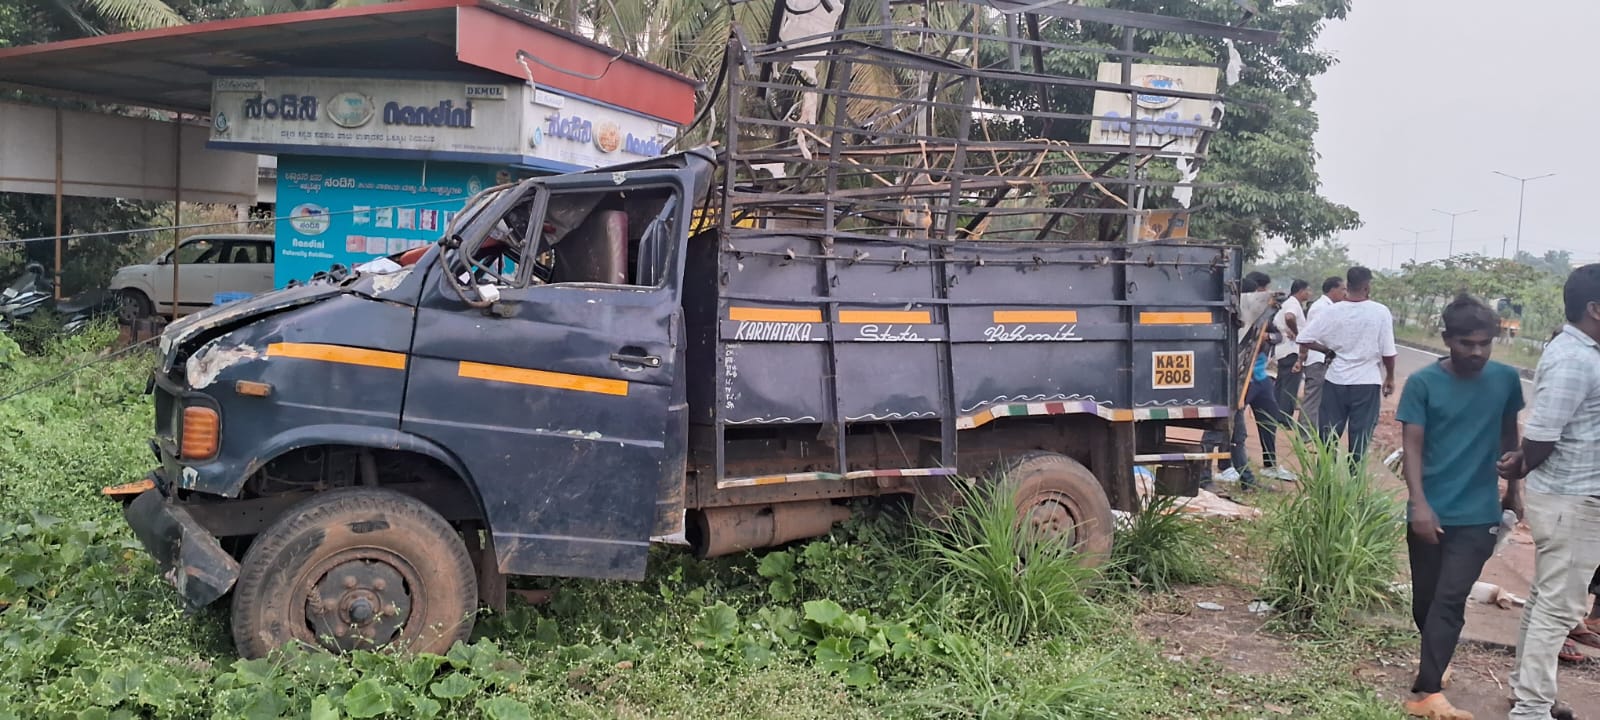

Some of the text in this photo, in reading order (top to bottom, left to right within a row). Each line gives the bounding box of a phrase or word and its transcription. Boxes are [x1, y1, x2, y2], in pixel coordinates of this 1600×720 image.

[467, 87, 502, 96] DKMUL
[245, 94, 318, 121] ನಂದಿನಿ
[383, 100, 473, 128] Nandini
[548, 112, 593, 144] ನಂದಿನಿ
[324, 177, 356, 189] ನಂದಿನಿ
[292, 238, 325, 249] Nandini
[734, 321, 813, 341] KARNATAKA
[1155, 369, 1192, 385] 7808
